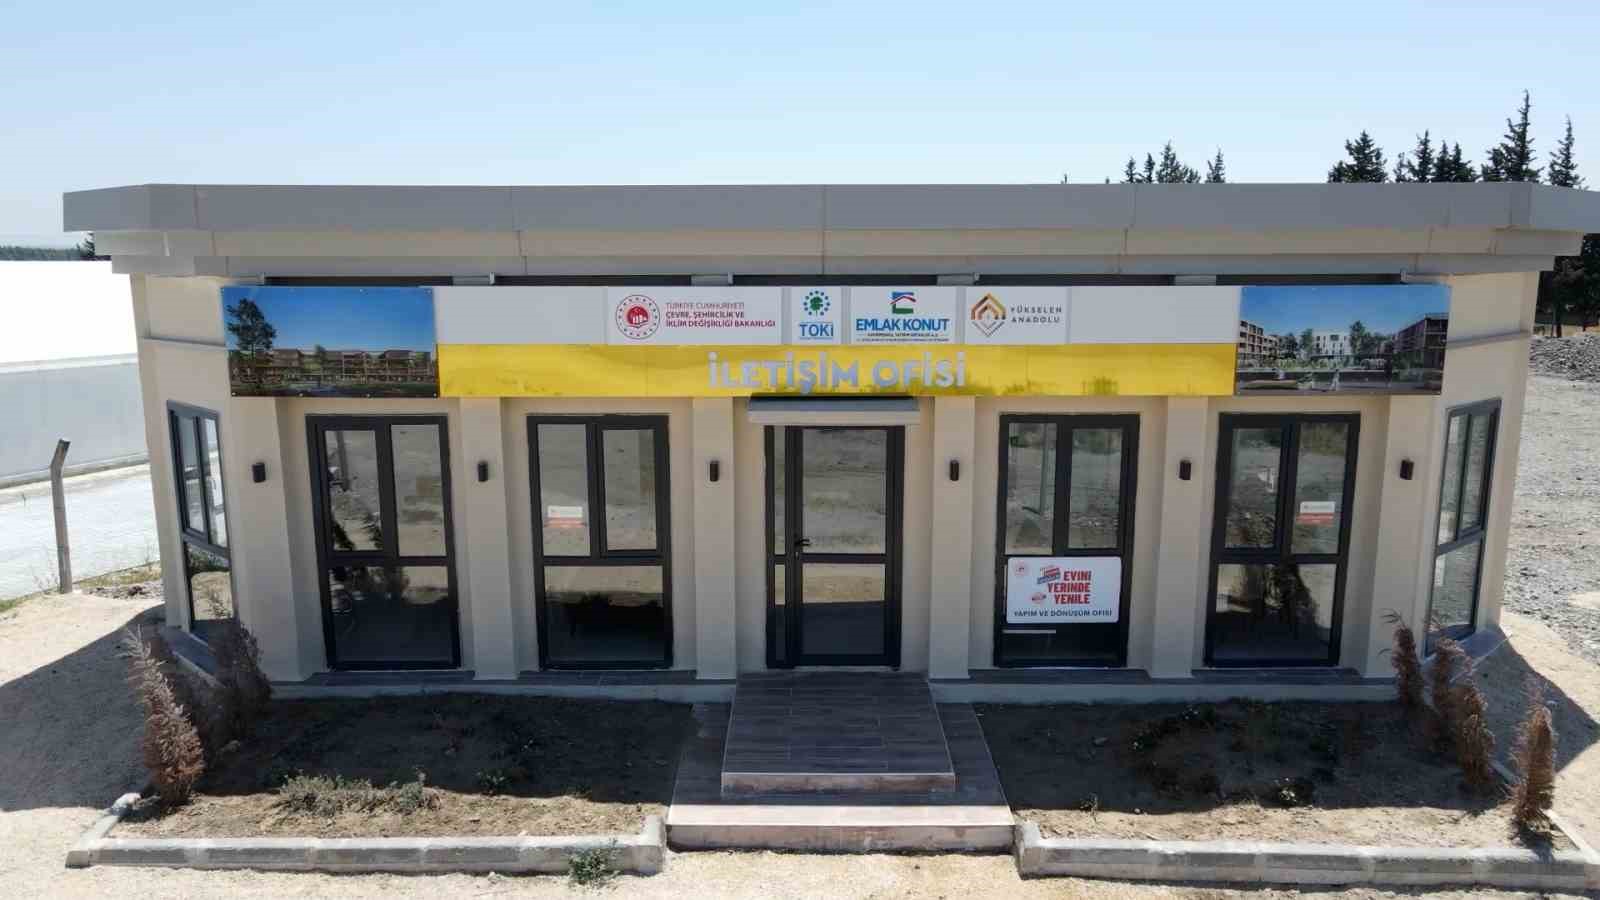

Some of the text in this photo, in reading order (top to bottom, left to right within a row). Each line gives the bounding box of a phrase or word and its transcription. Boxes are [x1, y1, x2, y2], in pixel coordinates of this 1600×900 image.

[1010, 305, 1061, 313] YÜKSELEN
[666, 319, 776, 328] İKLİM DEĞİŞİKLİĞİ BAKANLIĞI
[856, 319, 950, 331] EMLAK KONUT
[707, 351, 966, 394] İLETİŞİM OFİSİ
[1047, 583, 1091, 593] YERİNDE
[1055, 594, 1091, 605] YENİLE
[1039, 609, 1048, 617] VE
[1092, 608, 1112, 617] OFİSİ
